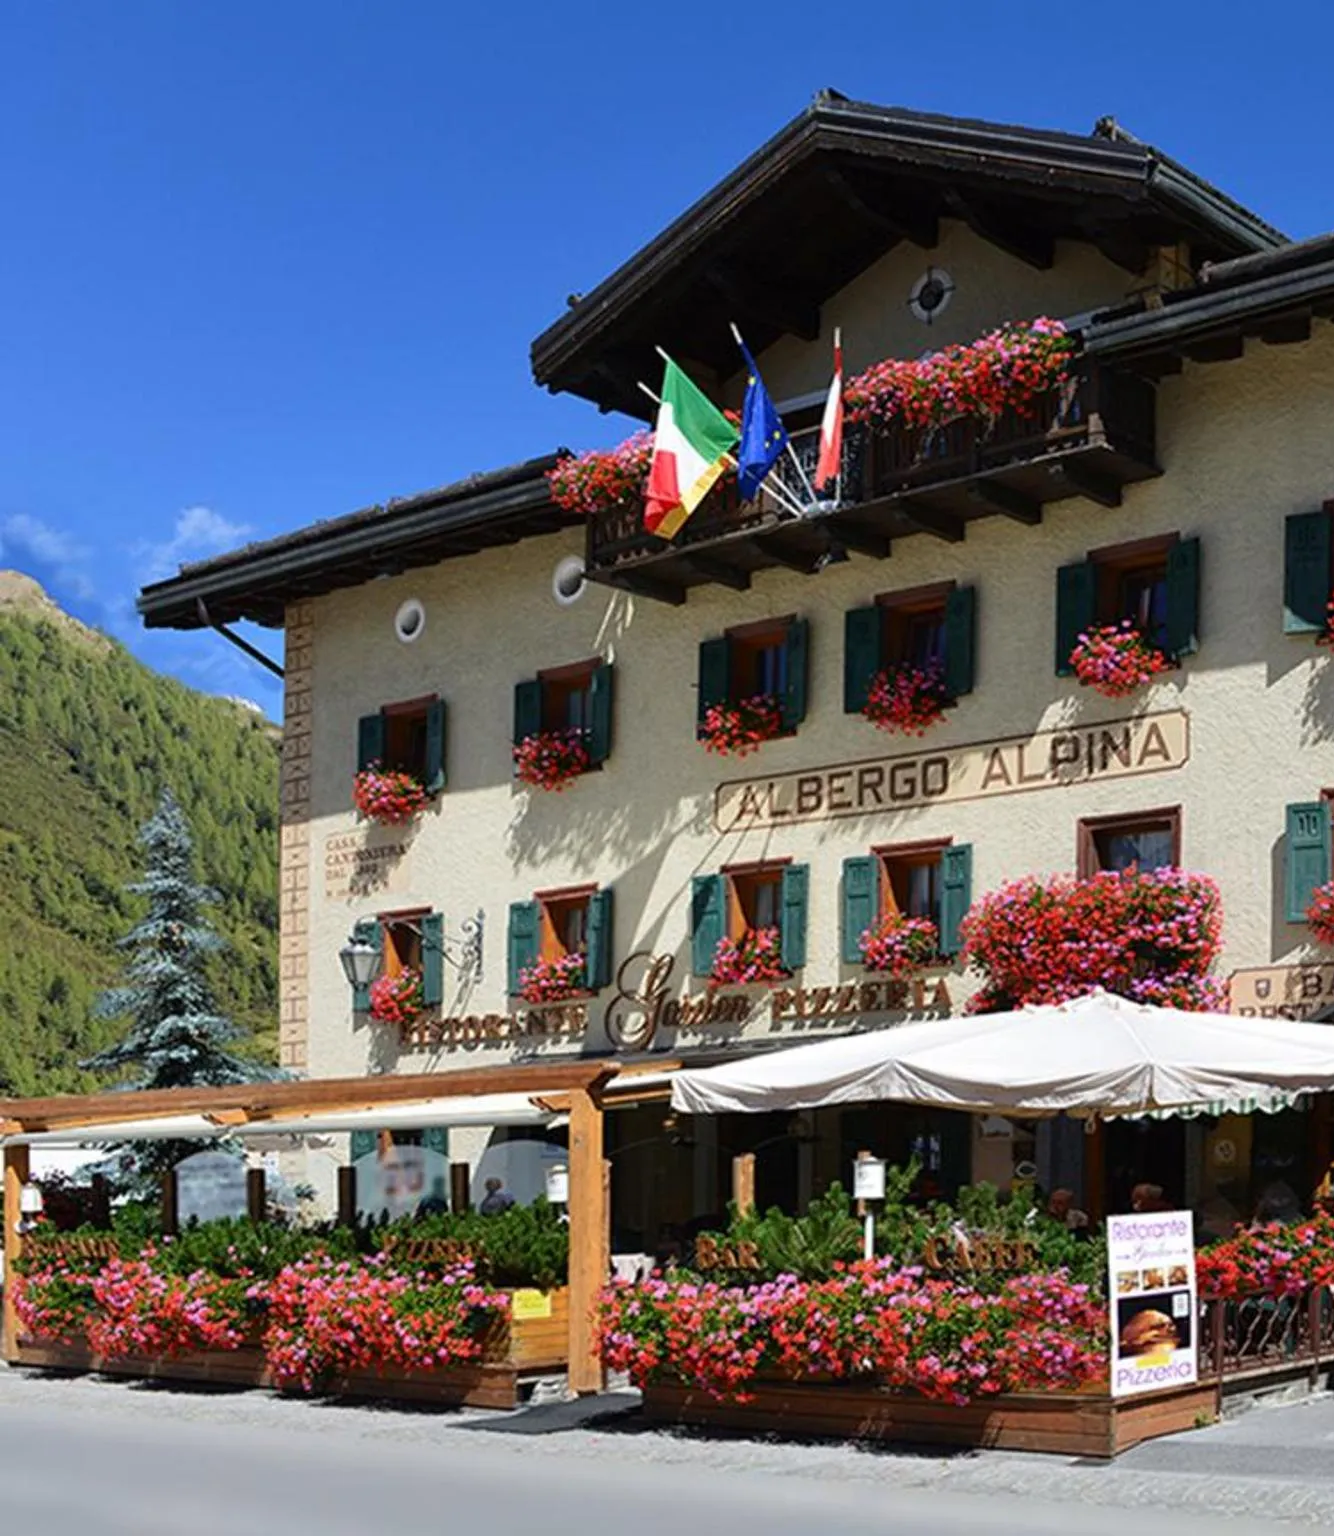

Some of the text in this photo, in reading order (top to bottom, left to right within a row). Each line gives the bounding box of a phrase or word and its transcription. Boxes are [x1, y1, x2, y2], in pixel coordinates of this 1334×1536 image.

[735, 721, 1172, 823] ALBERGO ALPINA
[399, 951, 954, 1050] RISTORANTE Garden PIZZERIA
[1111, 1219, 1188, 1241] Ristorante
[695, 1236, 762, 1271] BAR
[1116, 1361, 1192, 1389] Pizzeria
